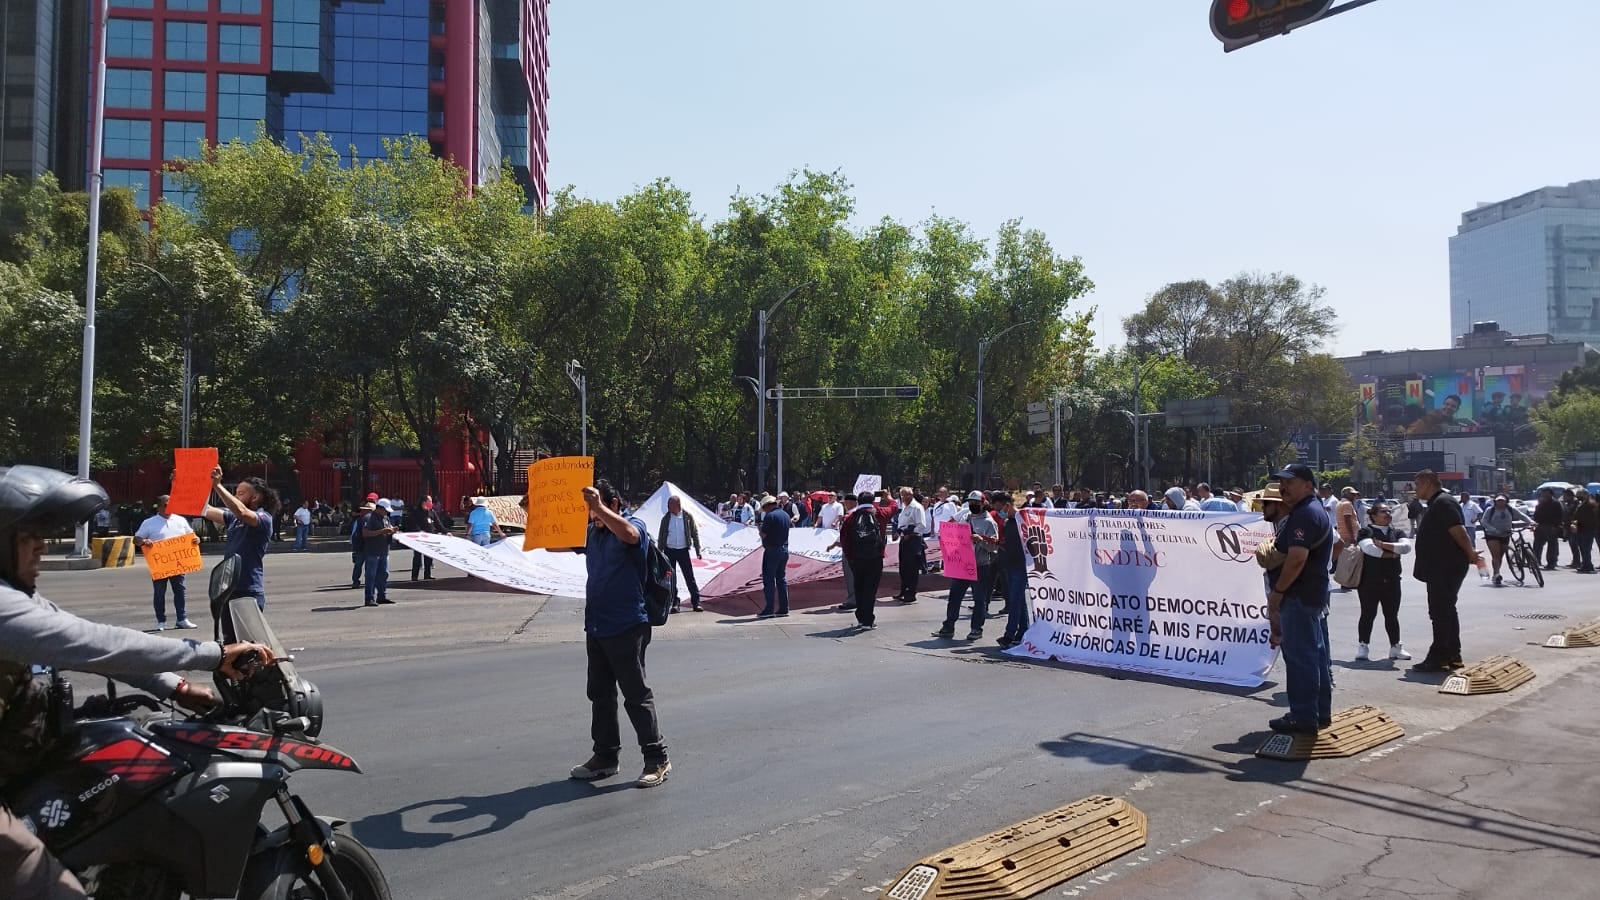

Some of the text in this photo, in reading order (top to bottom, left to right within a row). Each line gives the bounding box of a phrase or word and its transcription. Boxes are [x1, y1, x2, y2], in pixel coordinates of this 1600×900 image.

[1068, 530, 1079, 539] DE
[1142, 533, 1153, 543] DE
[1155, 533, 1198, 545] CULTURA
[1087, 519, 1167, 530] DE TRABAJADORES
[1094, 548, 1168, 568] SNDTSC
[1029, 586, 1270, 621] COMO SINDICATO DEMOCRÁTICO
[1056, 610, 1143, 634] RENUNCIARÉ
[1148, 620, 1159, 635] A
[1163, 621, 1190, 639] MIS
[1196, 624, 1270, 644] FORMAS
[1049, 630, 1227, 666] HISTÓRICAS DE LUCHA!
[78, 774, 120, 802] SECGOB
